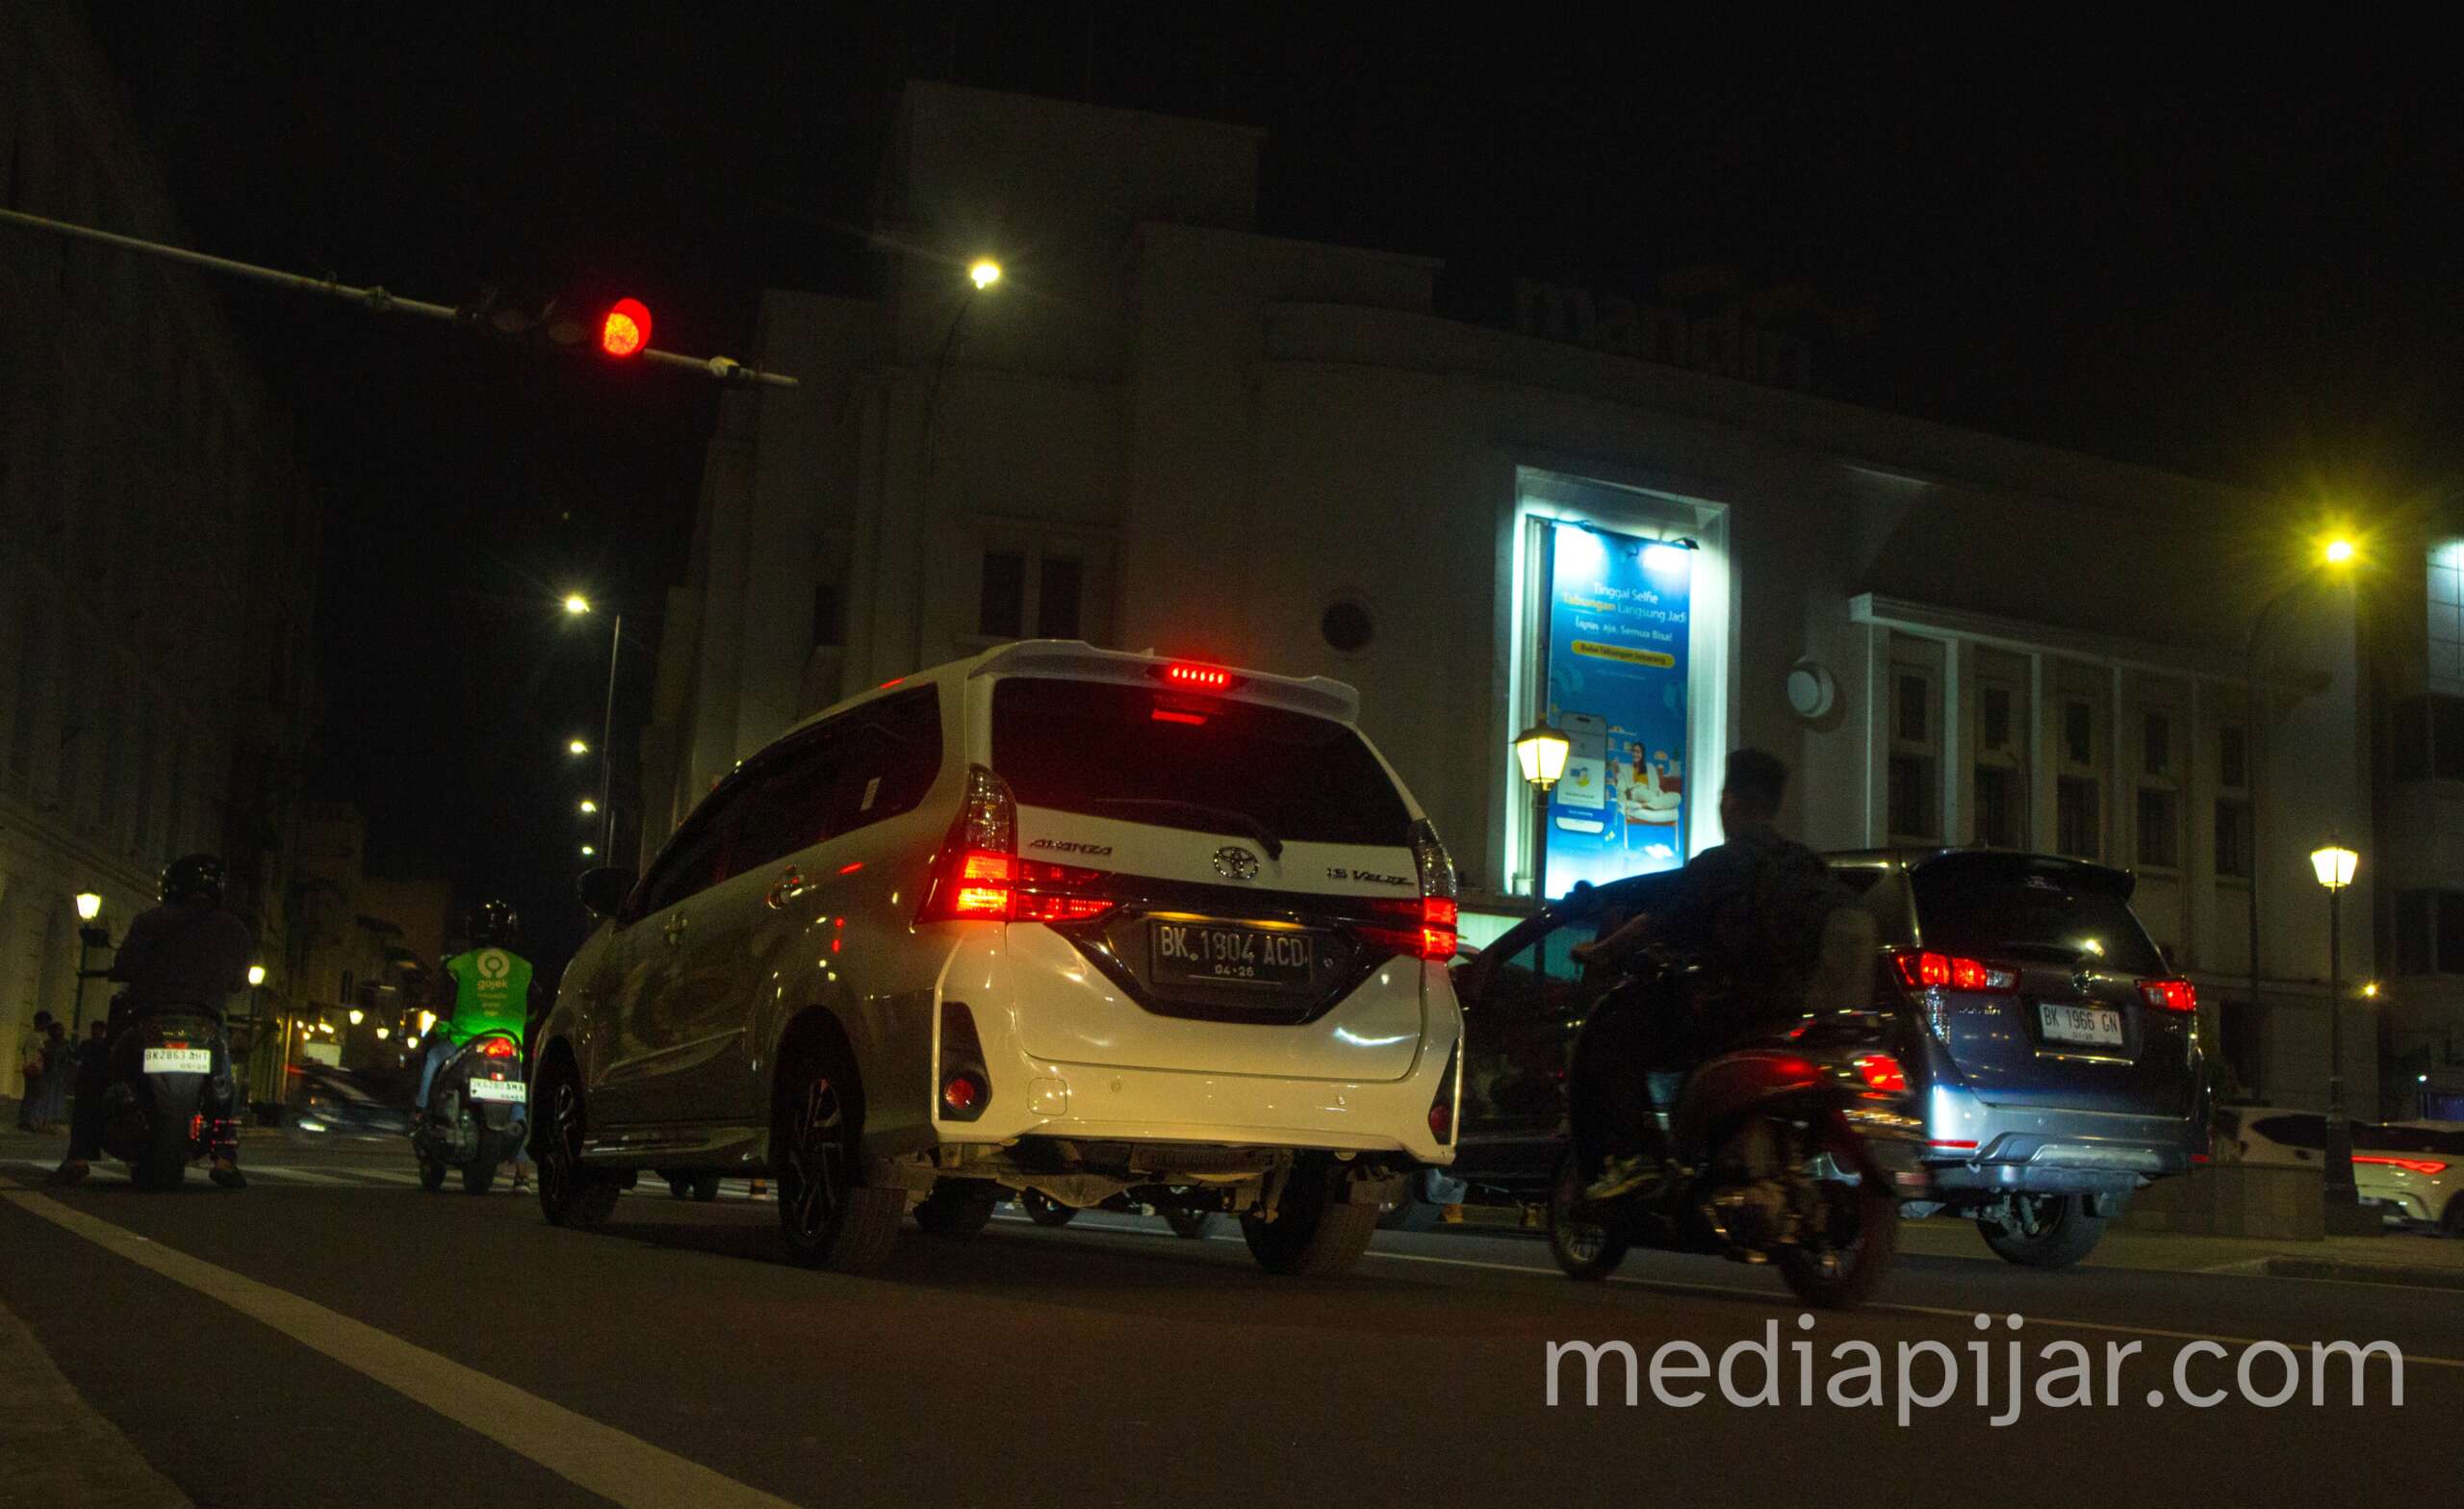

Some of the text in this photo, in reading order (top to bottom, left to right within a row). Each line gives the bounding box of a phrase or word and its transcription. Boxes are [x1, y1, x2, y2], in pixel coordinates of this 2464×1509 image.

[1200, 929, 1255, 960] 1804
[1263, 935, 1304, 966] ACD
[477, 978, 508, 991] gojek
[2043, 1007, 2060, 1027] BK
[2066, 1009, 2095, 1031] 1966
